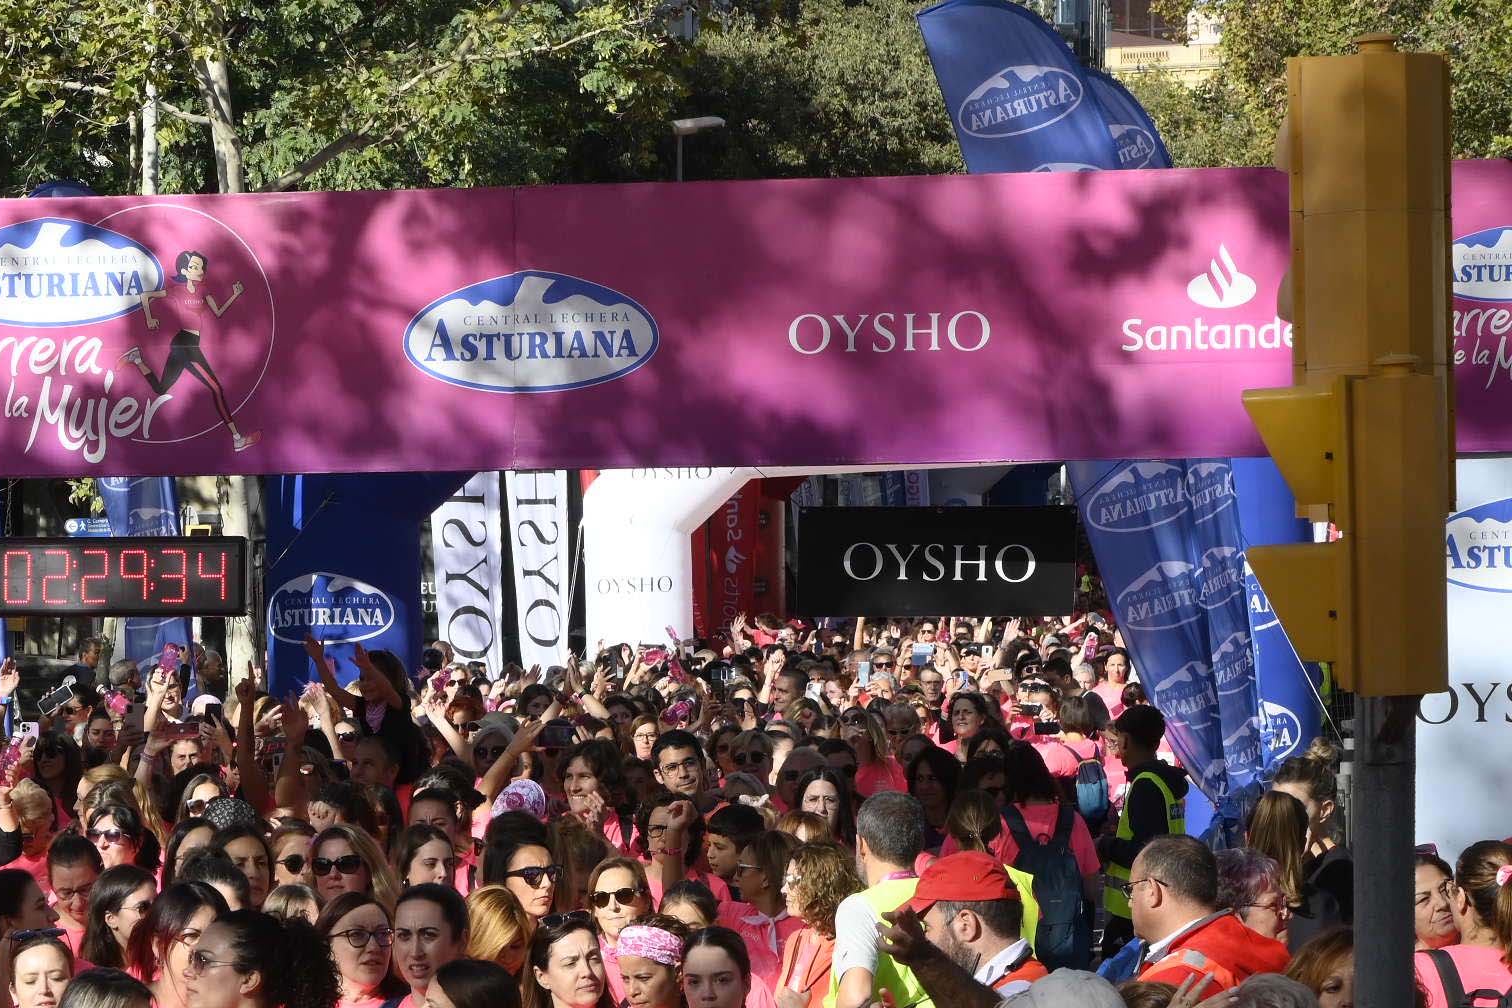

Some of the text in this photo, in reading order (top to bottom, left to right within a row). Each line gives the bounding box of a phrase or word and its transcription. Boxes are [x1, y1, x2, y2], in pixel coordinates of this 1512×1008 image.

[423, 318, 639, 362] ASTURIANA
[463, 311, 630, 327] CENTRAL LECHERA
[788, 310, 991, 355] OYSHO
[4, 378, 30, 418] la
[24, 369, 173, 464] Mujer
[3, 550, 226, 604] 02:29:34
[842, 542, 1036, 584] OYSHO
[598, 575, 673, 595] OYSHO
[273, 601, 384, 629] ASTURIANA
